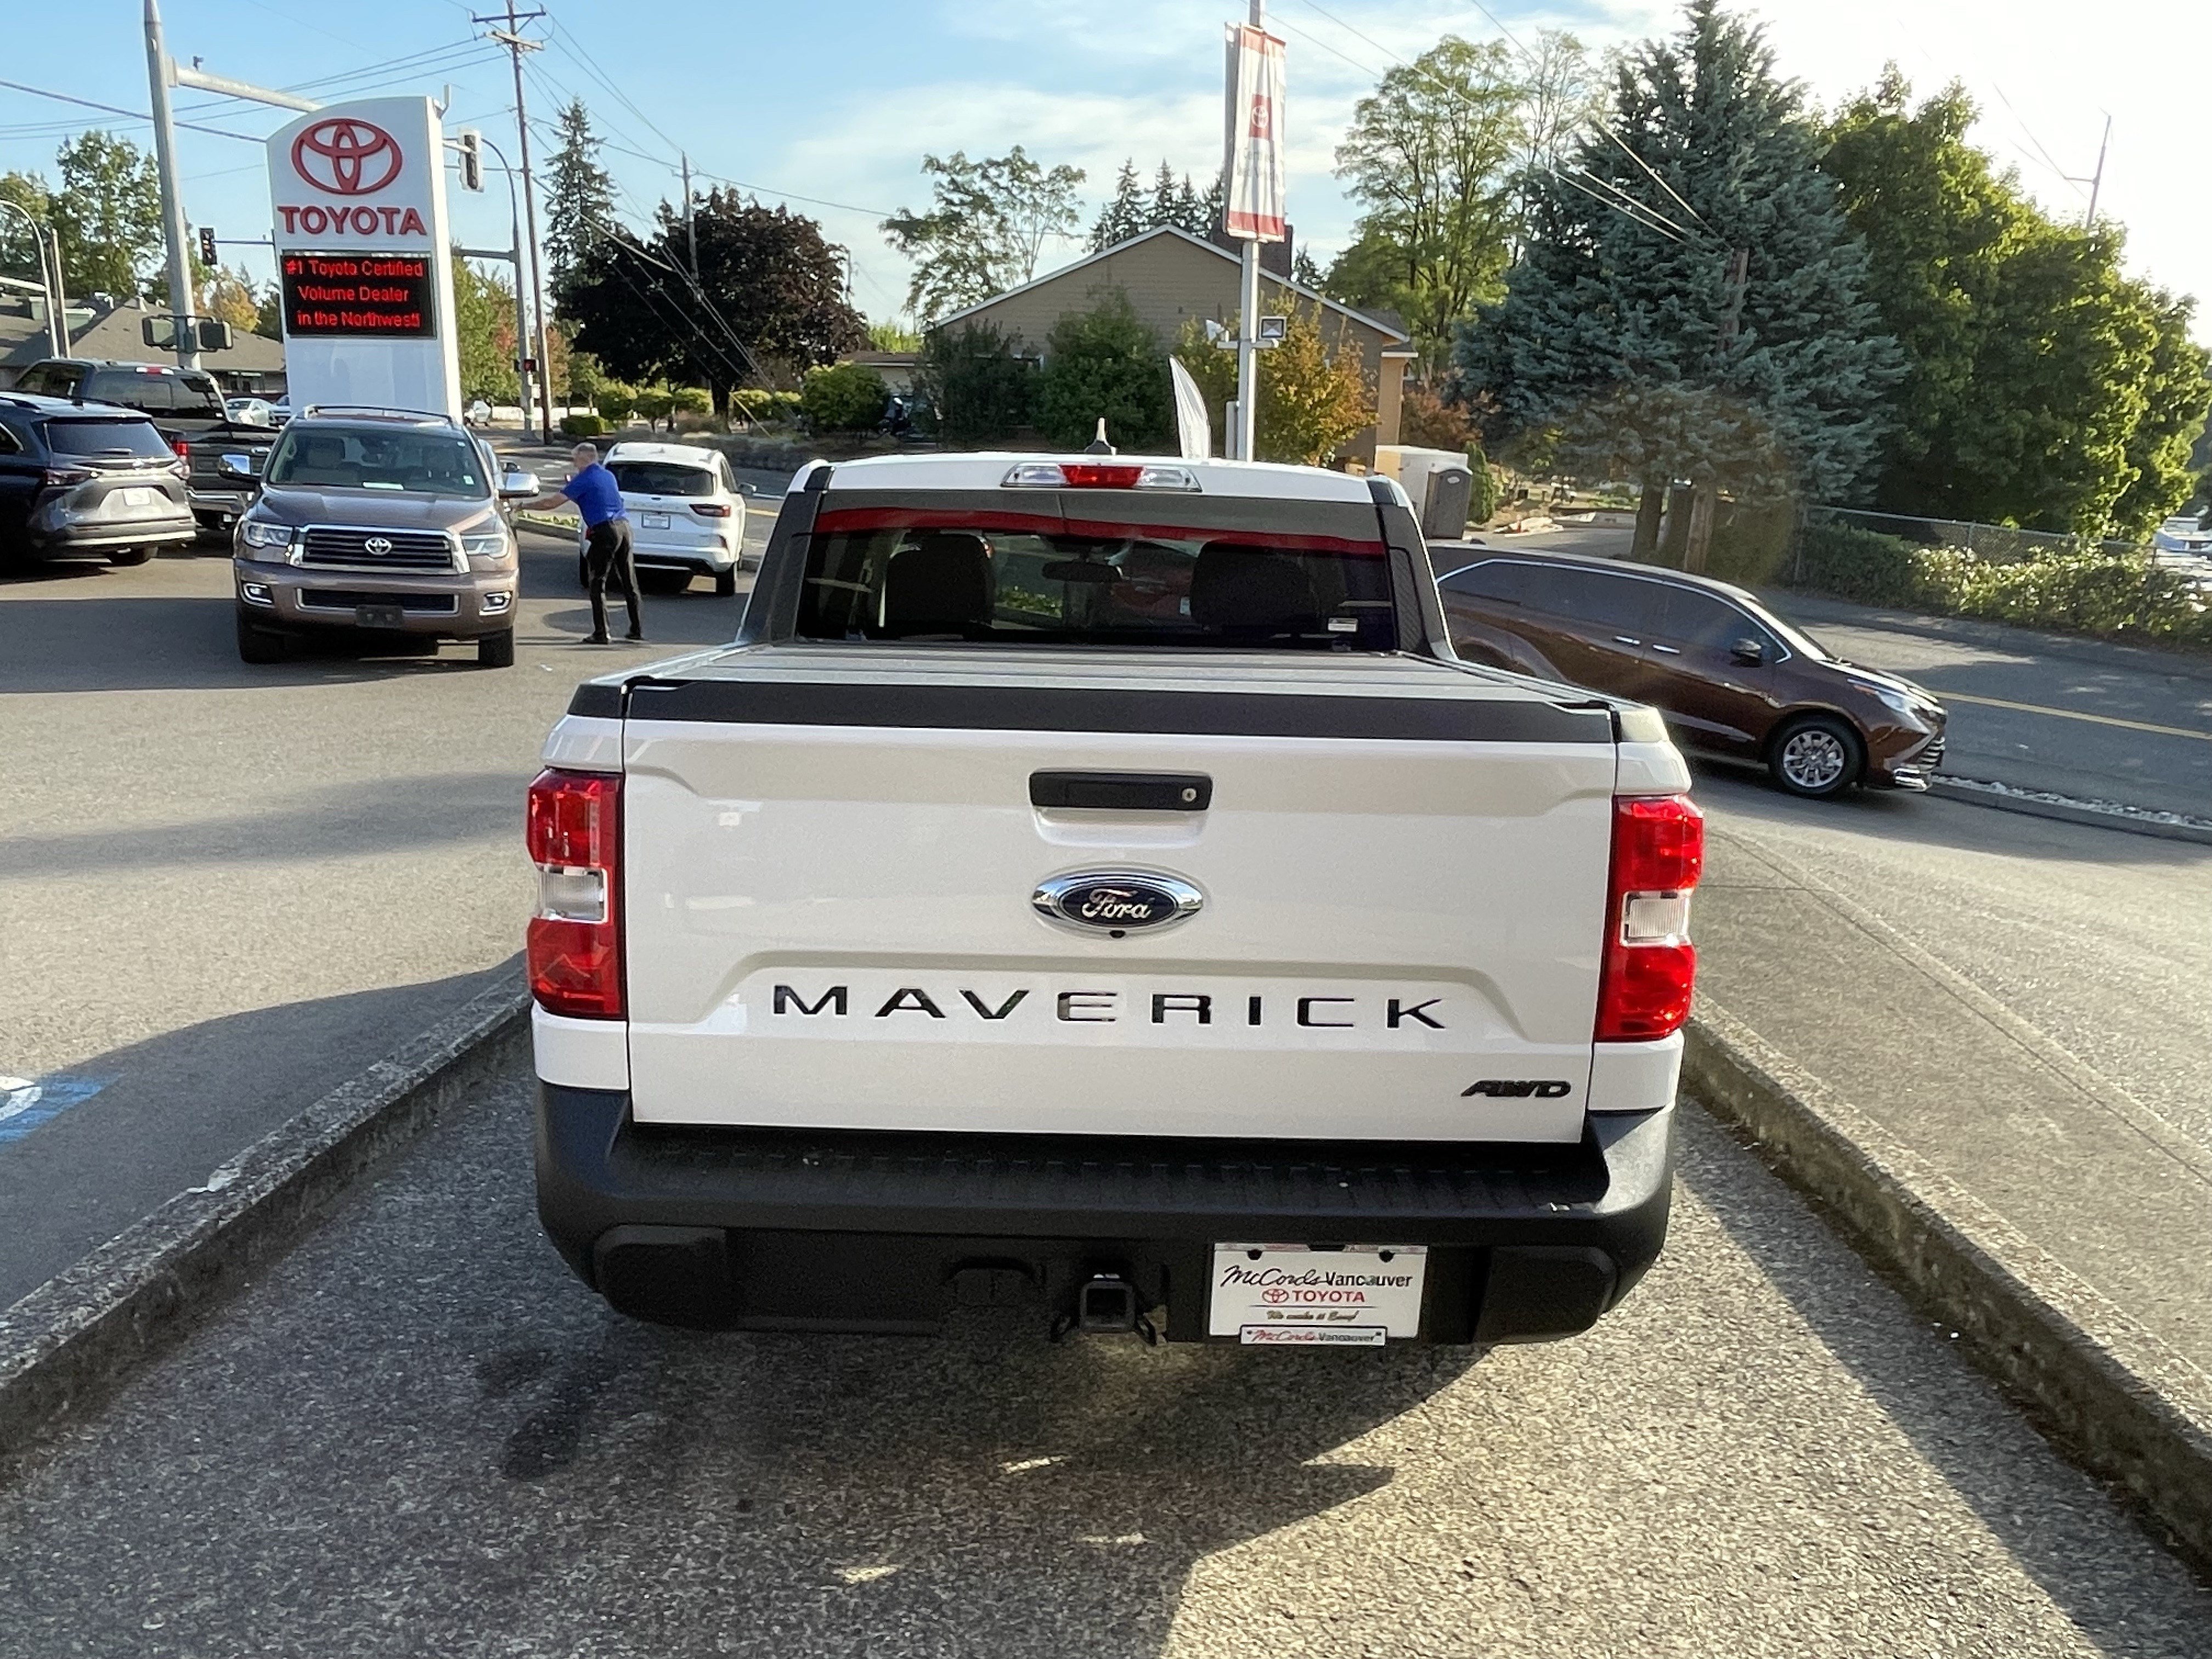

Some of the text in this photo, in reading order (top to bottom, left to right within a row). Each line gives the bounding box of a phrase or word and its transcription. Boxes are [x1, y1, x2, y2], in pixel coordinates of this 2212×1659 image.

[277, 205, 427, 236] TOYOTA
[285, 259, 424, 278] #1 Toyota Certified
[297, 285, 409, 302] Volume Dealer
[297, 310, 312, 326] in
[314, 311, 338, 326] the
[1082, 889, 1155, 918] Ford
[773, 984, 1446, 1029] MAVERICK
[1460, 1080, 1571, 1098] AWD
[1292, 1290, 1365, 1302] TOYOTA
